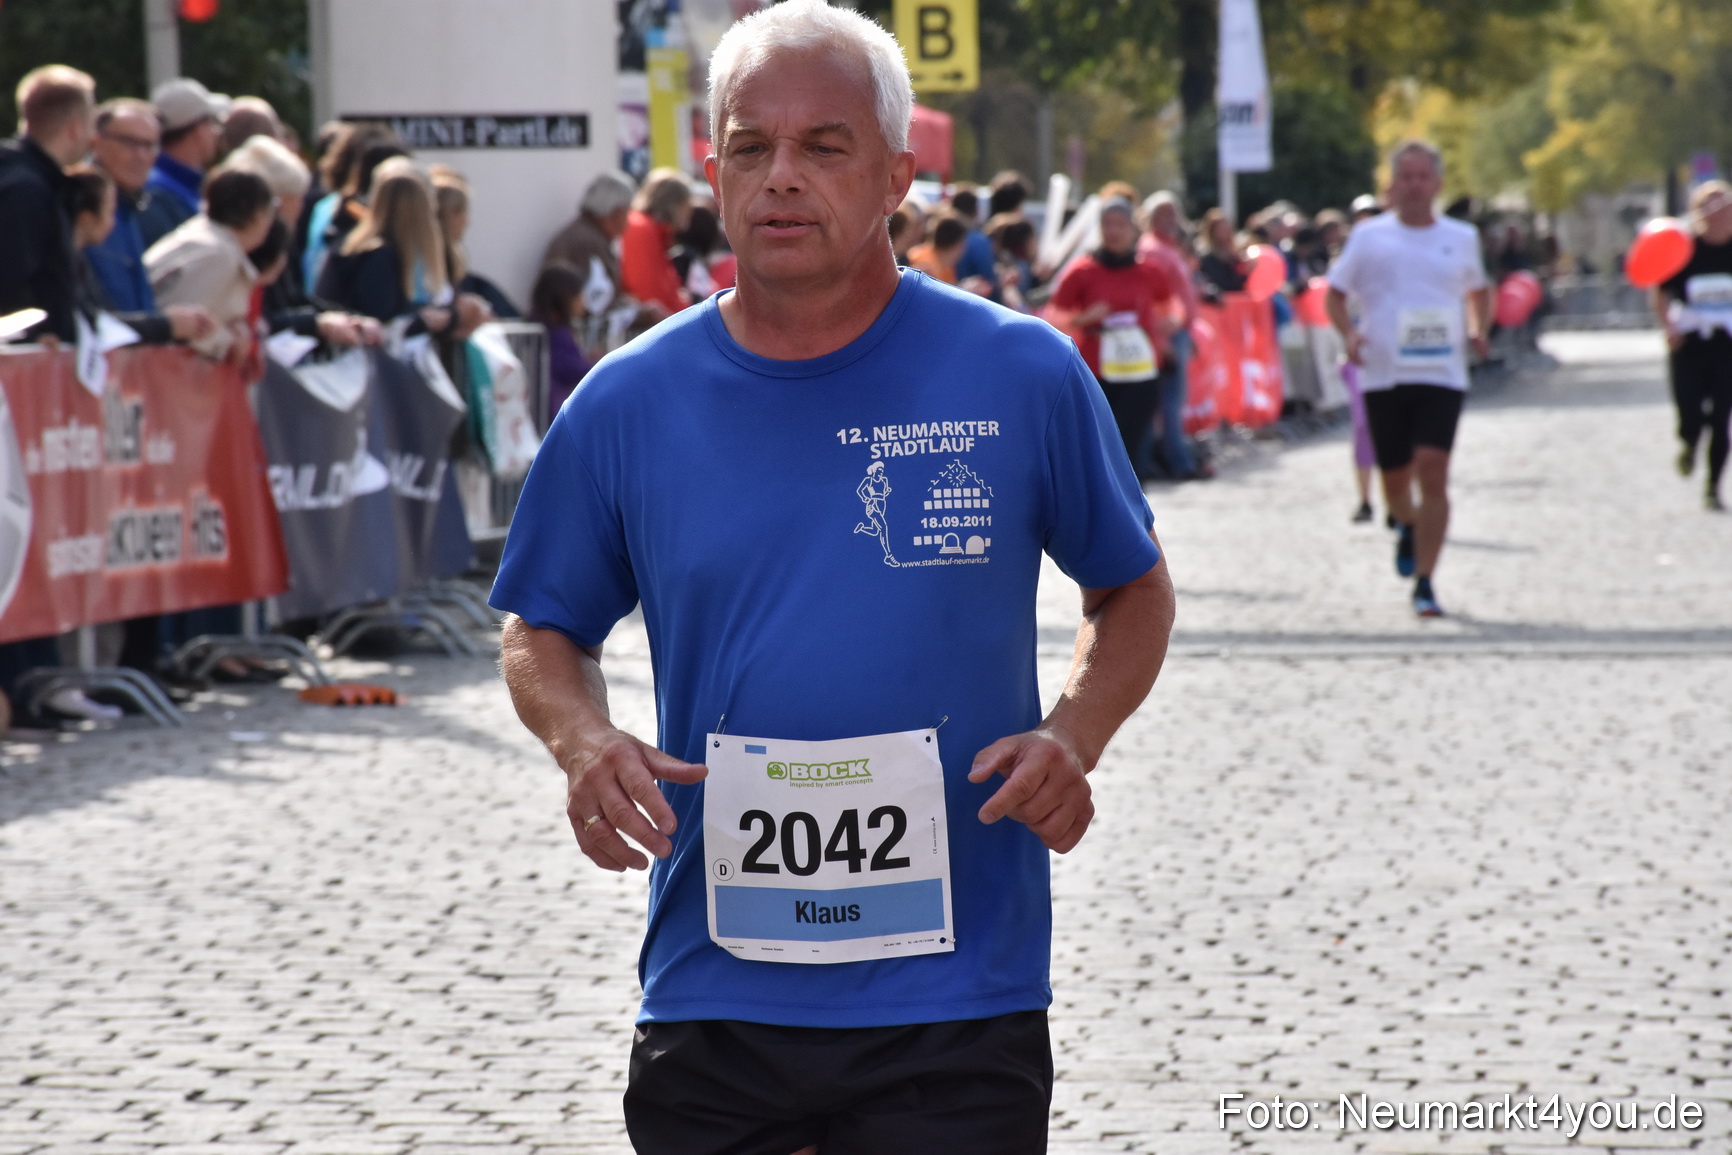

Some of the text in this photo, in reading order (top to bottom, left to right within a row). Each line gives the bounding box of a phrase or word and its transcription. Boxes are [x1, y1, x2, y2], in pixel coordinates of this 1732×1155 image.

[918, 6, 954, 60] B
[836, 420, 1000, 445] 12. NEUMARKTER
[870, 437, 976, 460] STADTLAUF
[920, 515, 993, 529] 18.09.2011
[901, 556, 990, 568] www.stadtlauf-neumarkt.de
[789, 758, 872, 781] BOCK
[789, 777, 874, 789] inspired by smart concepts
[739, 804, 911, 877] 2042
[719, 864, 728, 876] D
[795, 900, 861, 925] Klaus
